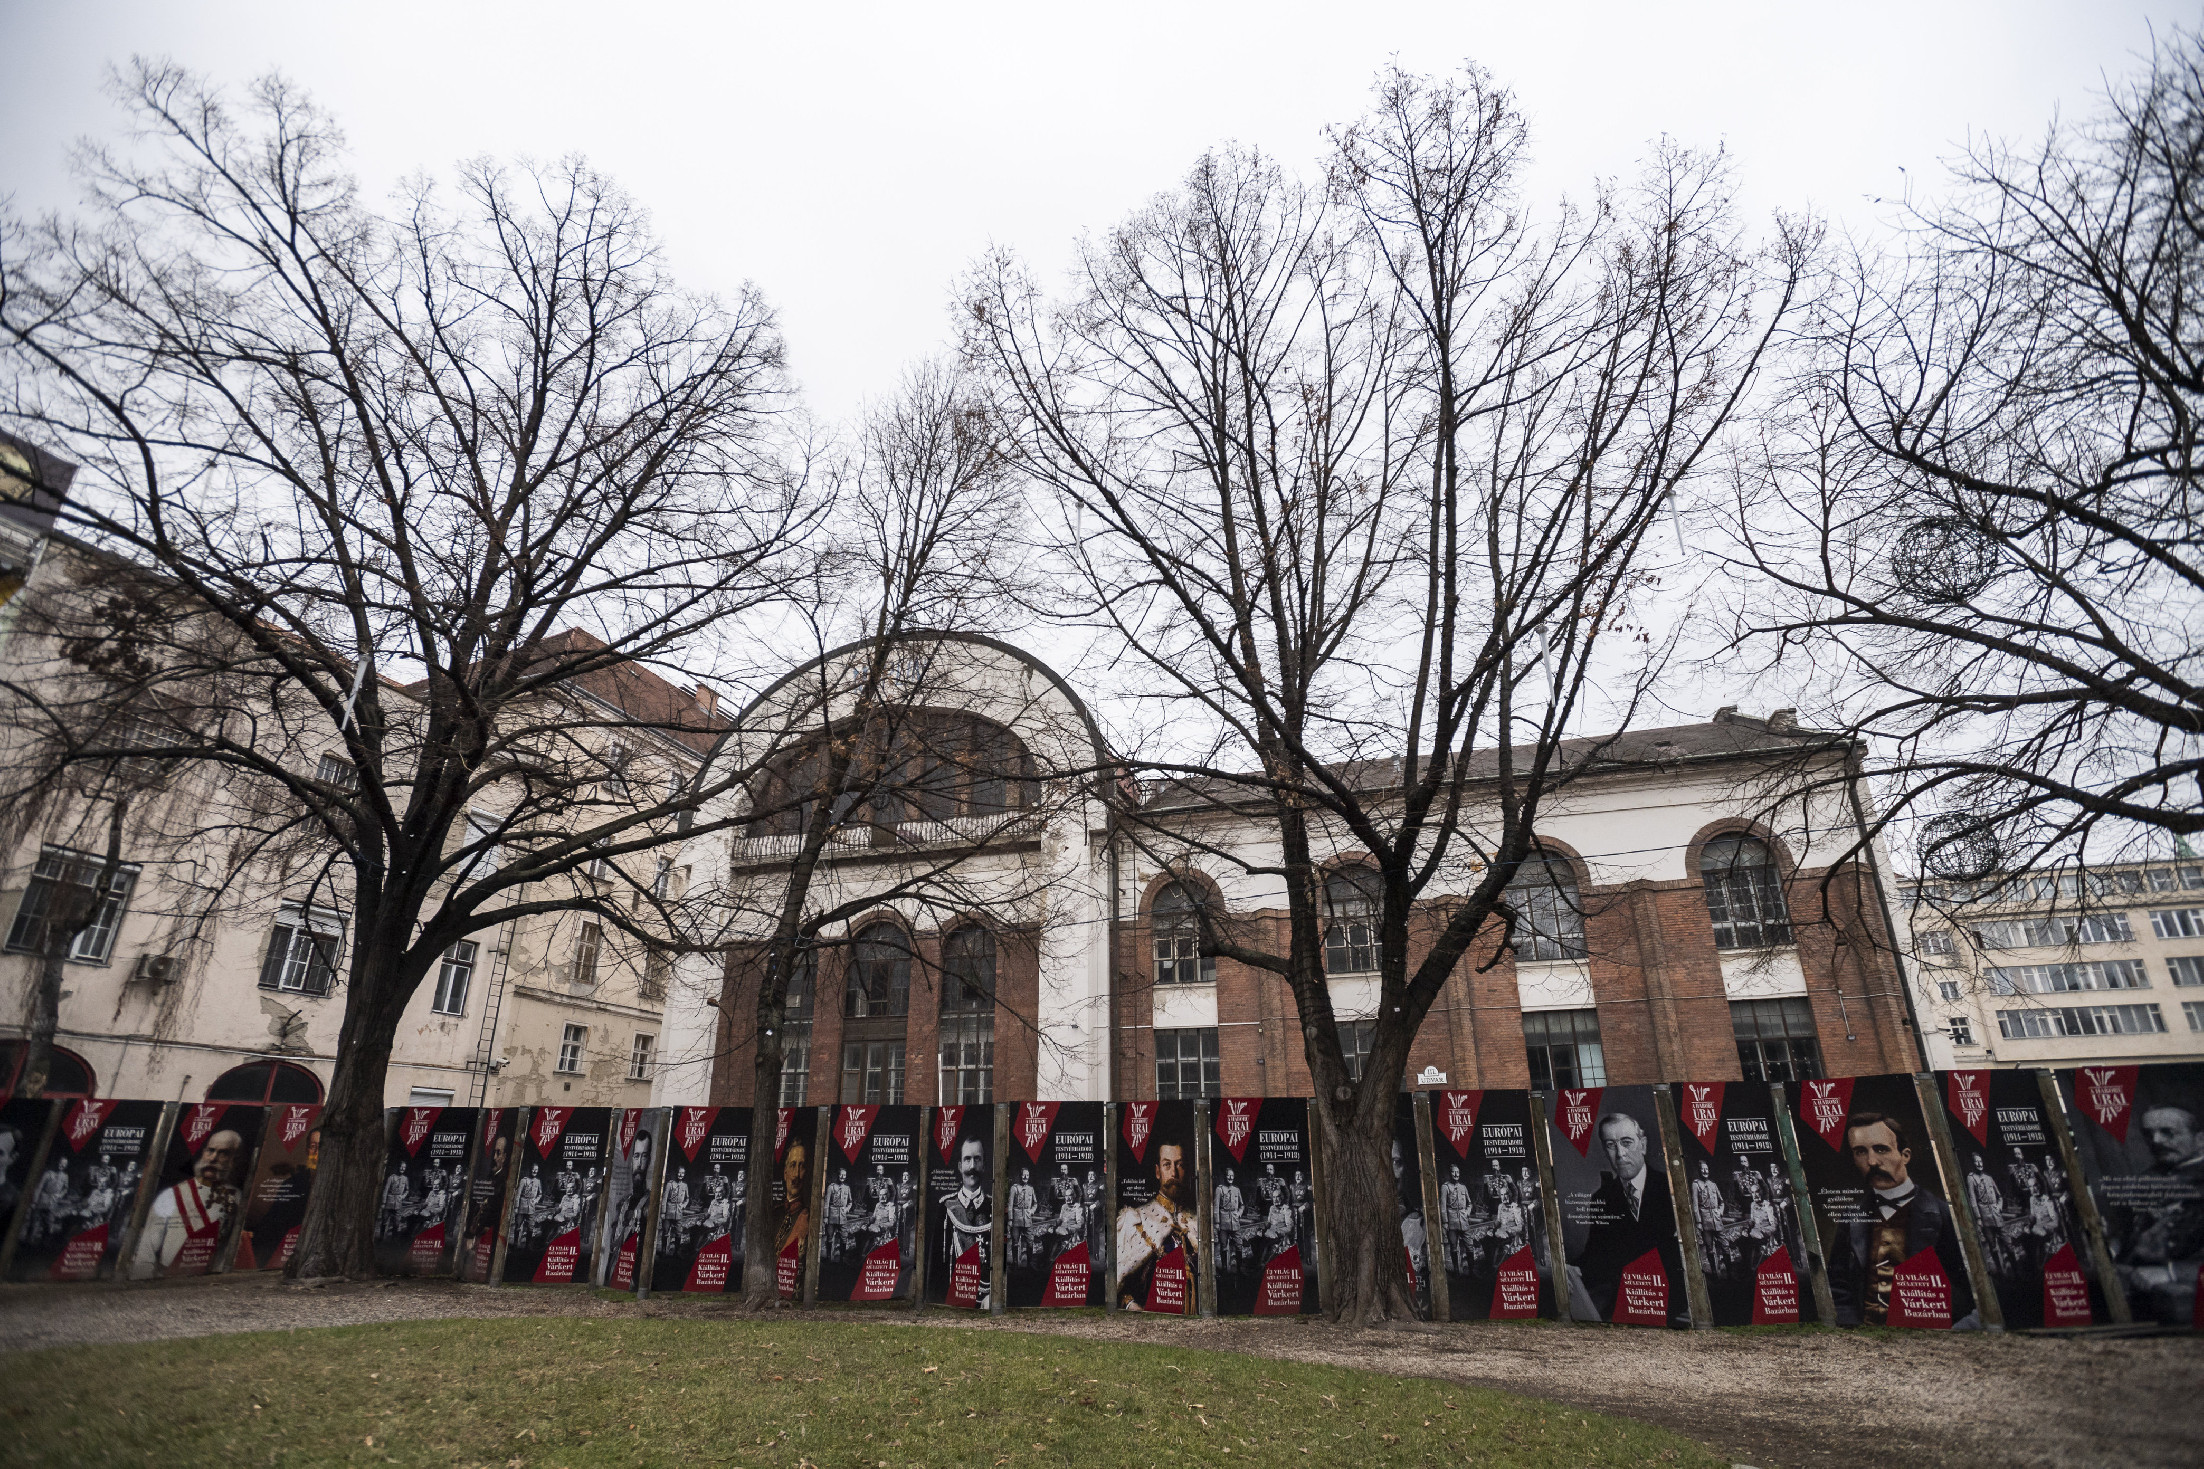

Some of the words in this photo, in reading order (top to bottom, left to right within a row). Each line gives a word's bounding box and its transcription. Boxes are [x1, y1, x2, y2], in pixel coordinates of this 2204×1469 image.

[1960, 1098, 1984, 1108] URAI
[2091, 1093, 2126, 1108] URAI
[1693, 1108, 1716, 1119] URAI
[1814, 1104, 1844, 1116] URAI
[1449, 1115, 1471, 1124] URAI
[1568, 1112, 1591, 1122] URAI
[1996, 1109, 2038, 1122] EURÓPAI
[846, 1126, 865, 1134] URAI
[1026, 1124, 1046, 1132] URAI
[1132, 1124, 1148, 1132] URAI
[1228, 1122, 1248, 1130] URAI
[1727, 1119, 1768, 1132] EURÓPAI
[942, 1127, 956, 1136] URAI
[1482, 1126, 1522, 1138] EURÓPAI
[565, 1134, 599, 1144] EURÓPAI
[712, 1136, 746, 1146] EURÓPAI
[874, 1136, 909, 1146] EURÓPAI
[1056, 1133, 1094, 1144] EURÓPAI
[1260, 1132, 1298, 1142] EURÓPAI
[889, 1260, 898, 1269] II.
[1079, 1264, 1088, 1274] II.
[1292, 1270, 1300, 1280] II.
[1525, 1271, 1536, 1282] II.
[1783, 1272, 1795, 1284] II.
[1652, 1275, 1666, 1286] II.
[1930, 1275, 1946, 1288] II.
[956, 1284, 976, 1292] Várkert
[1056, 1283, 1086, 1291] Várkert
[1626, 1288, 1656, 1296] Kiállítás
[1156, 1288, 1182, 1297] Várkert
[1502, 1292, 1535, 1302] Várkert
[1900, 1289, 1936, 1298] Kiállítás
[1157, 1296, 1182, 1305] Bazárban
[1627, 1296, 1664, 1307] Várkert
[1762, 1296, 1796, 1305] Várkert
[1902, 1298, 1947, 1310] Várkert
[2052, 1298, 2086, 1308] Várkert
[1628, 1306, 1666, 1316] Bazárban
[1764, 1306, 1798, 1314] Bazárban
[1904, 1309, 1950, 1318] Bazárban
